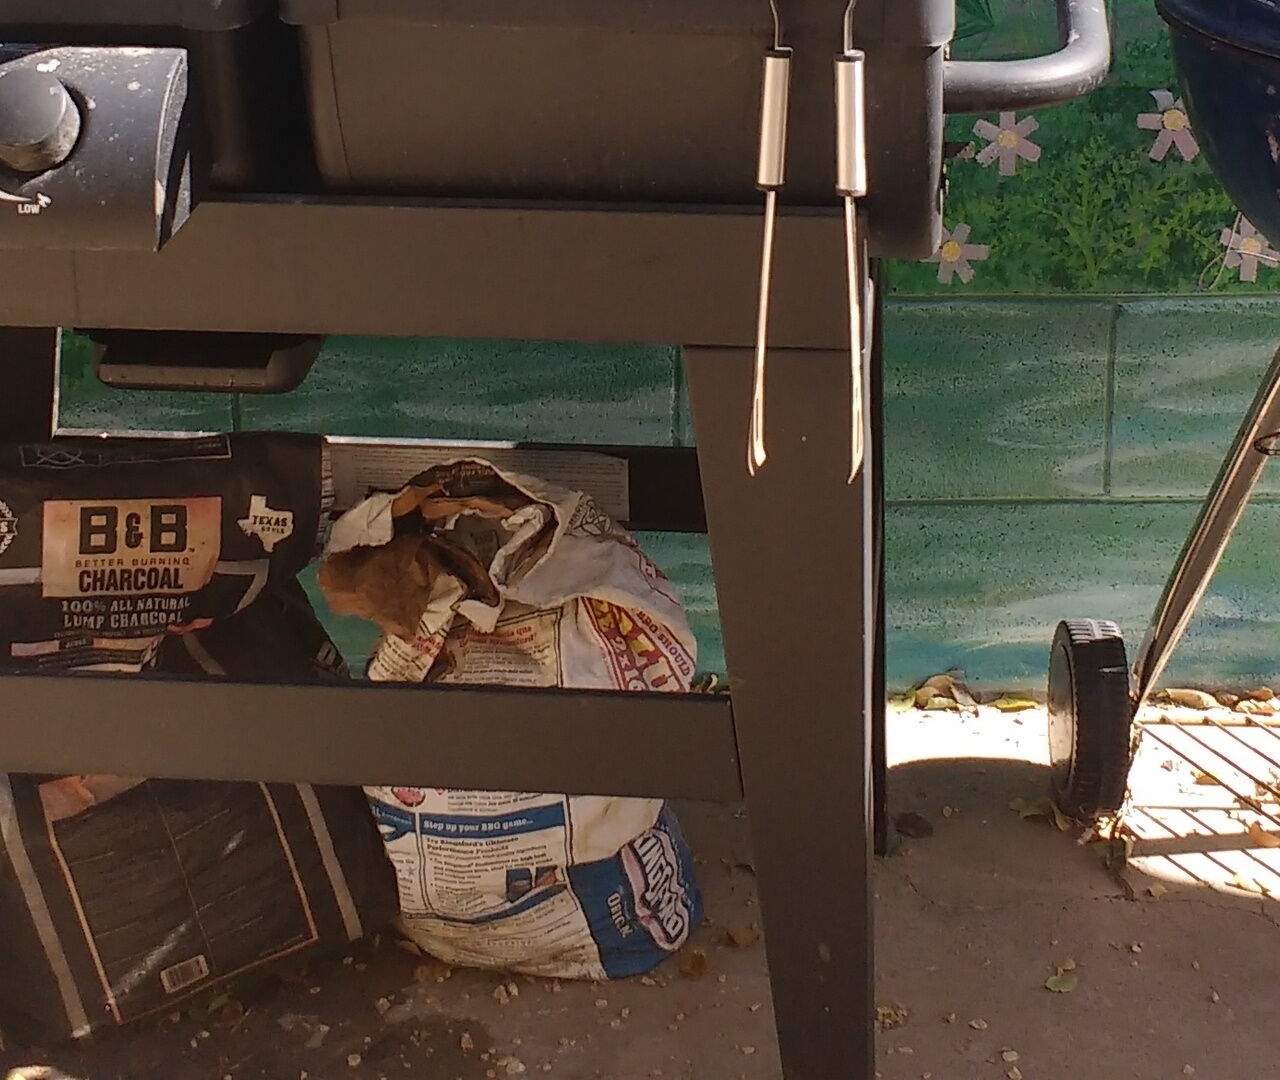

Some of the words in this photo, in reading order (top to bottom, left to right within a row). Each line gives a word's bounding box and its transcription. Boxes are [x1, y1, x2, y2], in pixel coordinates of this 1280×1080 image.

[17, 203, 41, 215] LOW
[252, 514, 288, 527] TEXAS
[78, 504, 188, 555] B&B
[74, 558, 124, 568] BETTER
[131, 556, 191, 566] BURNING
[78, 566, 184, 593] CHARCOAL
[61, 599, 107, 613] 100%
[110, 599, 134, 612] ALL
[136, 595, 191, 612] NATURAL
[63, 613, 106, 629] LUMP
[110, 610, 183, 628] CHARCOAL
[423, 820, 444, 831] Step
[445, 823, 458, 833] up
[459, 823, 480, 833] your
